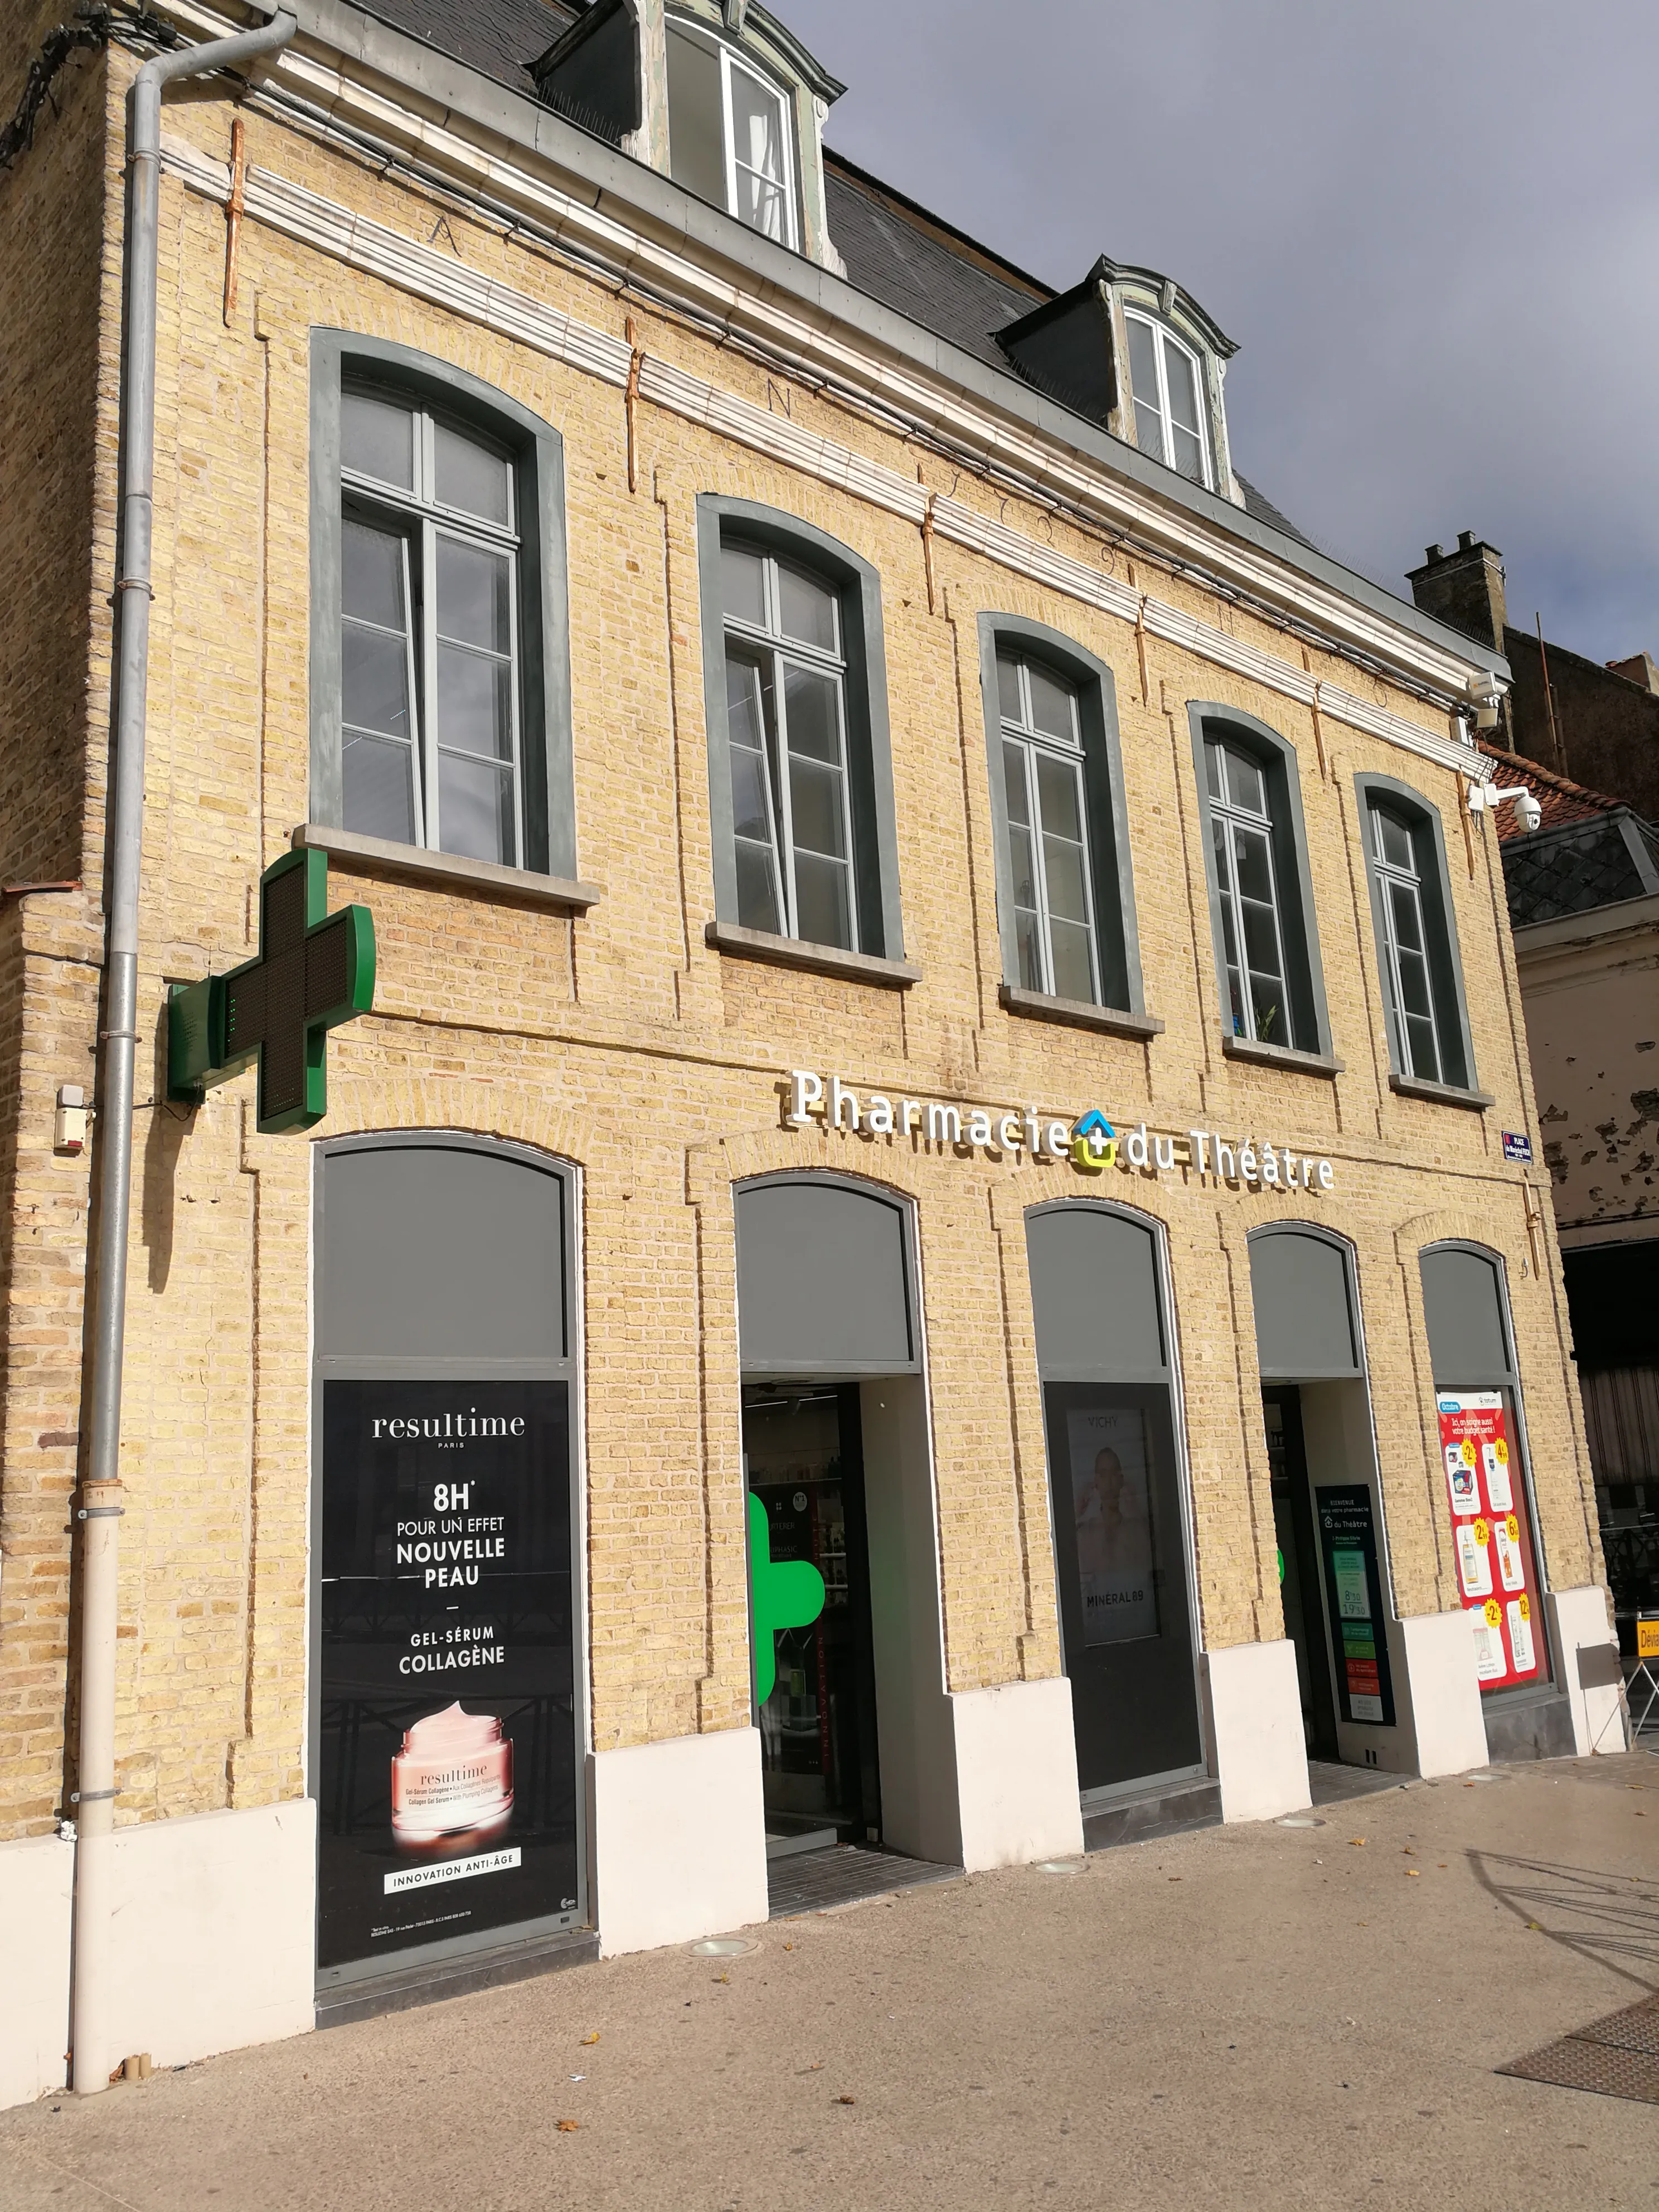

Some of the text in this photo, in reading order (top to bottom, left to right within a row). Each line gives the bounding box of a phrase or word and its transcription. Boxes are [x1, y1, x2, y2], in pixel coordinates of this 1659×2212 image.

[785, 1070, 1335, 1190] Pharmacie du Théâtre
[1514, 1137, 1525, 1146] PLACE
[372, 1408, 525, 1438] resultime
[1088, 1417, 1118, 1428] VICHY
[1452, 1418, 1460, 1428] Ici,
[1466, 1418, 1481, 1427] soigne
[1481, 1417, 1493, 1425] aussi
[1464, 1426, 1481, 1436] budget
[1481, 1425, 1492, 1434] santé
[397, 1517, 505, 1536] POUR UN EFFET
[397, 1537, 505, 1564] NOUVELLE
[425, 1565, 479, 1589] PEAU
[1087, 1589, 1143, 1608] MINÉRAL 89
[410, 1626, 494, 1647] GEL-SÉRUM
[399, 1645, 505, 1674] COLLAGÈNE
[421, 1765, 487, 1785] resultime
[394, 1855, 513, 1888] INNOVATION ANTI-ÂGE
